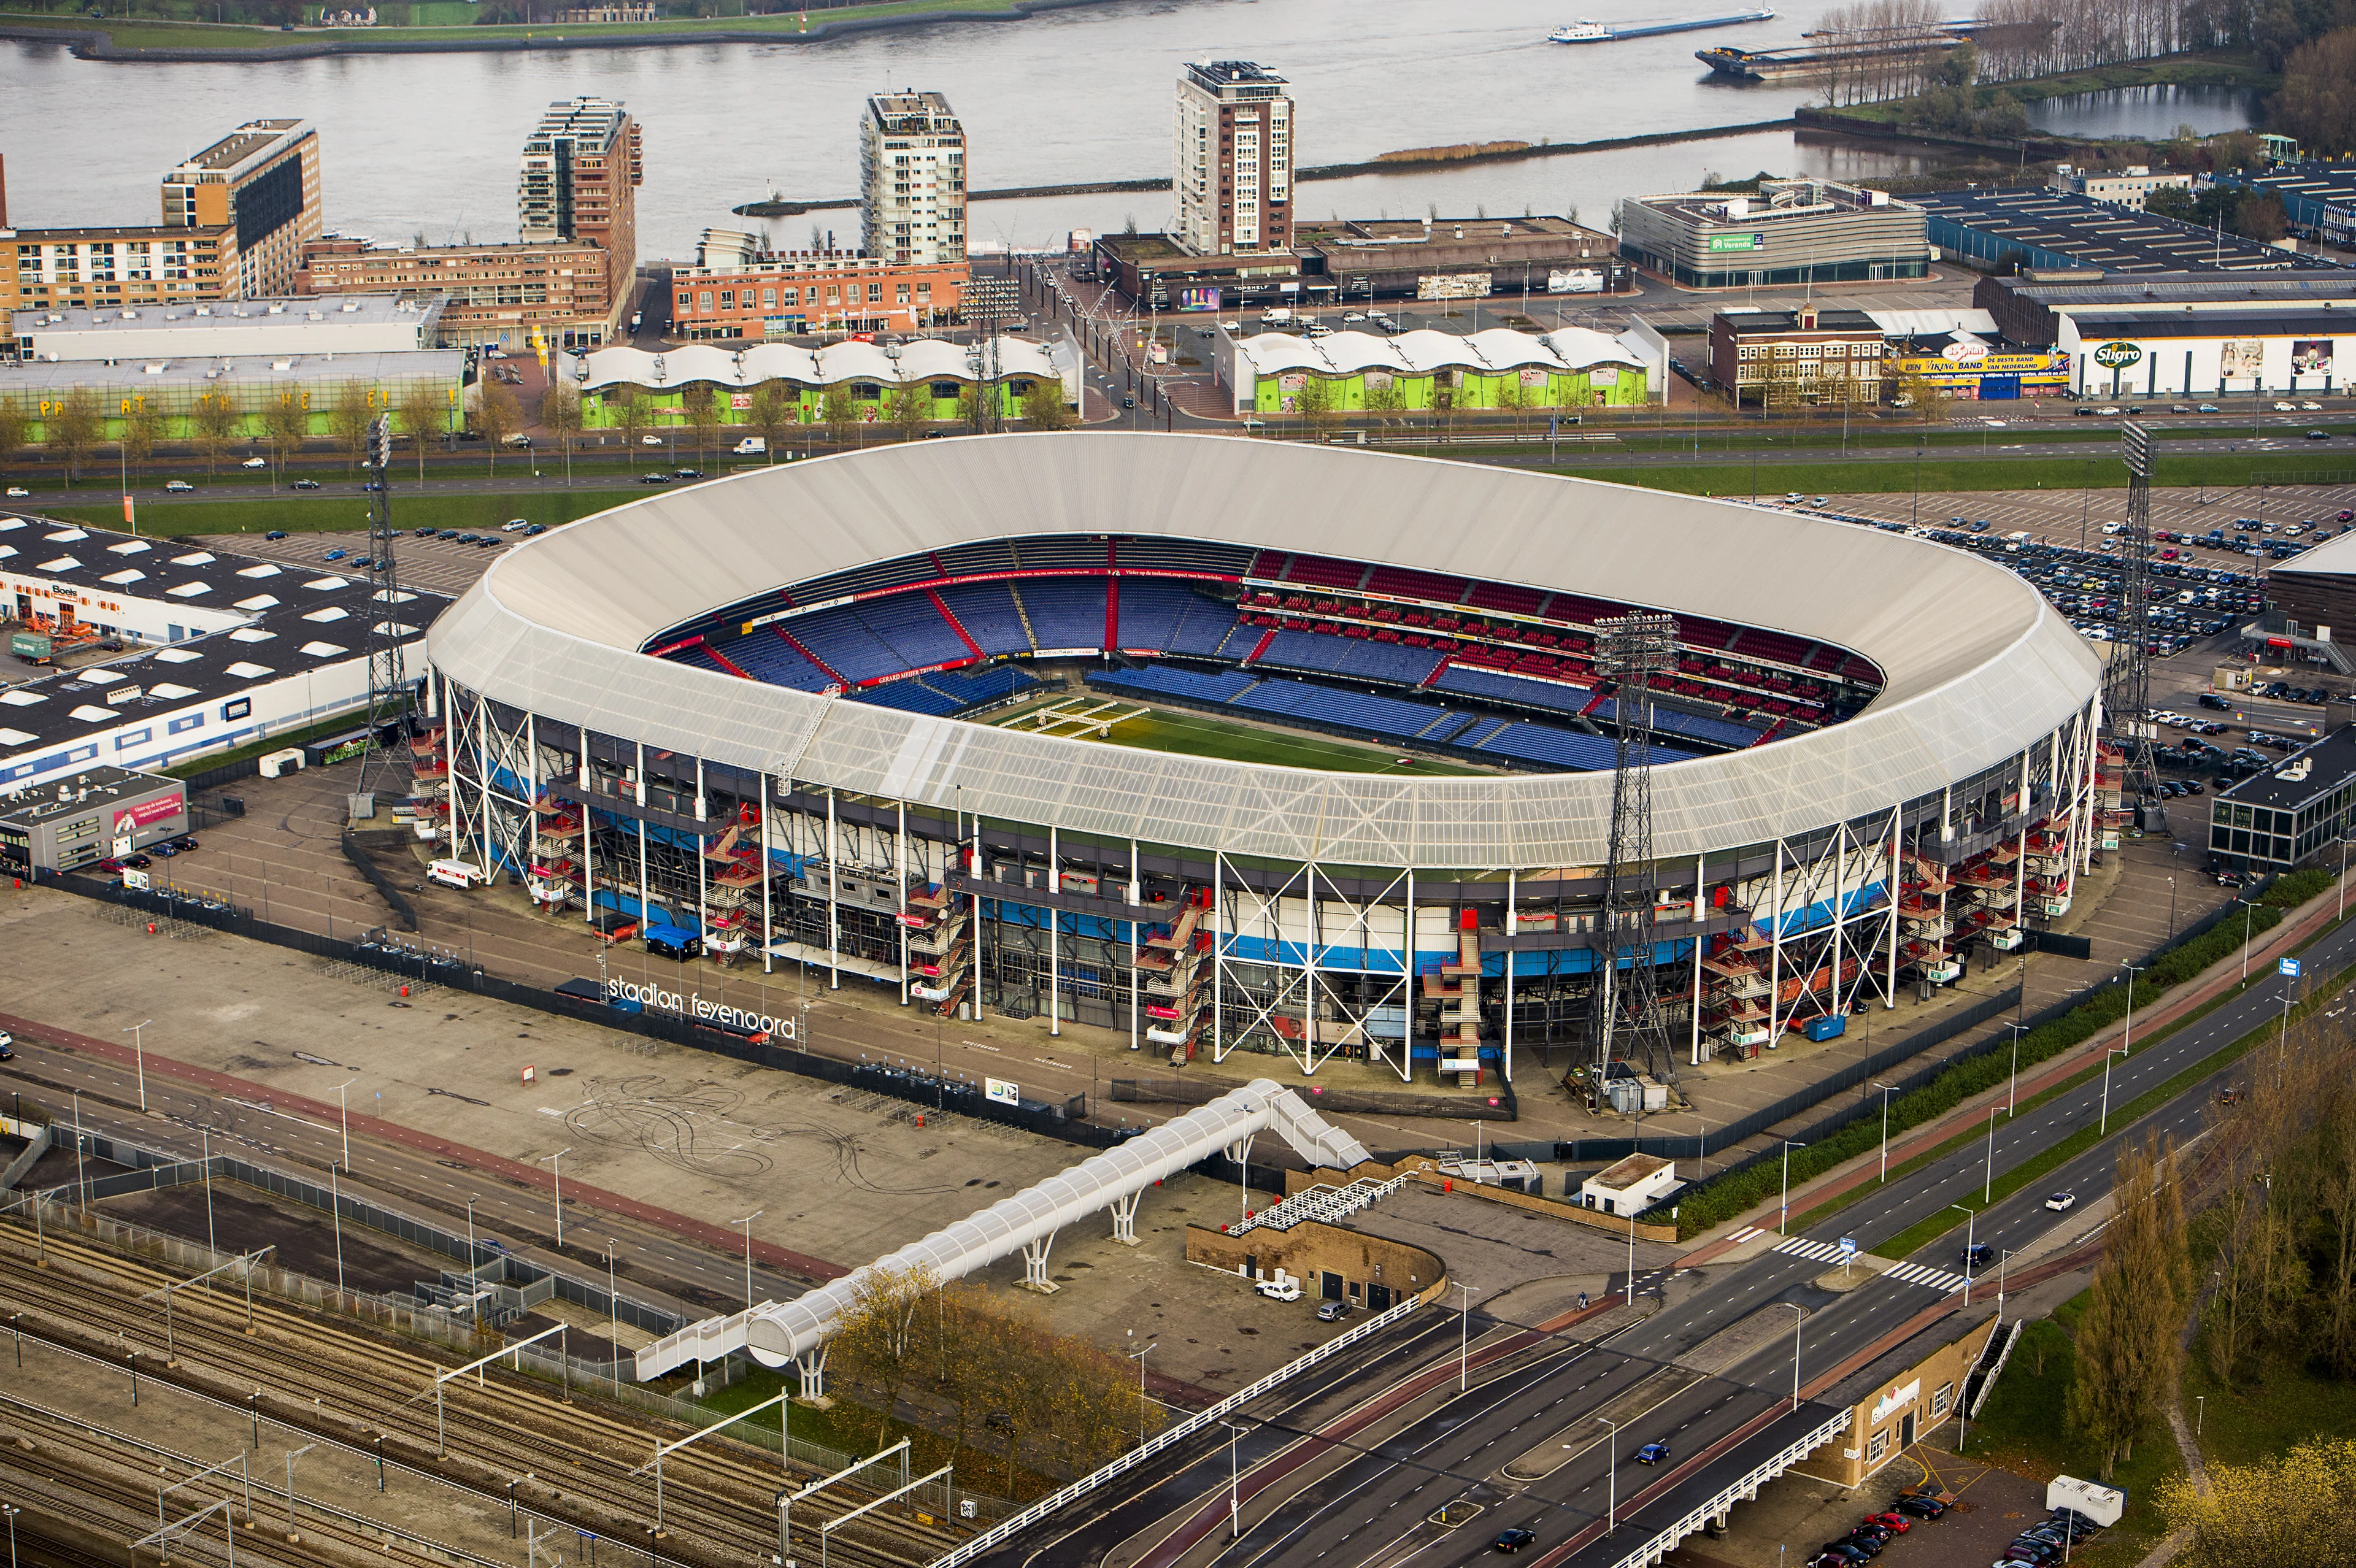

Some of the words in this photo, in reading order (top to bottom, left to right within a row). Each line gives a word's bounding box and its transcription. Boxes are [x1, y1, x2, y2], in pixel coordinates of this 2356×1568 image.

[2096, 347, 2141, 363] Sligro
[52, 585, 77, 597] Boels
[879, 674, 900, 684] GERARD
[900, 670, 920, 678] MEIJER
[608, 974, 683, 1013] stadion
[691, 991, 796, 1040] feyenoord
